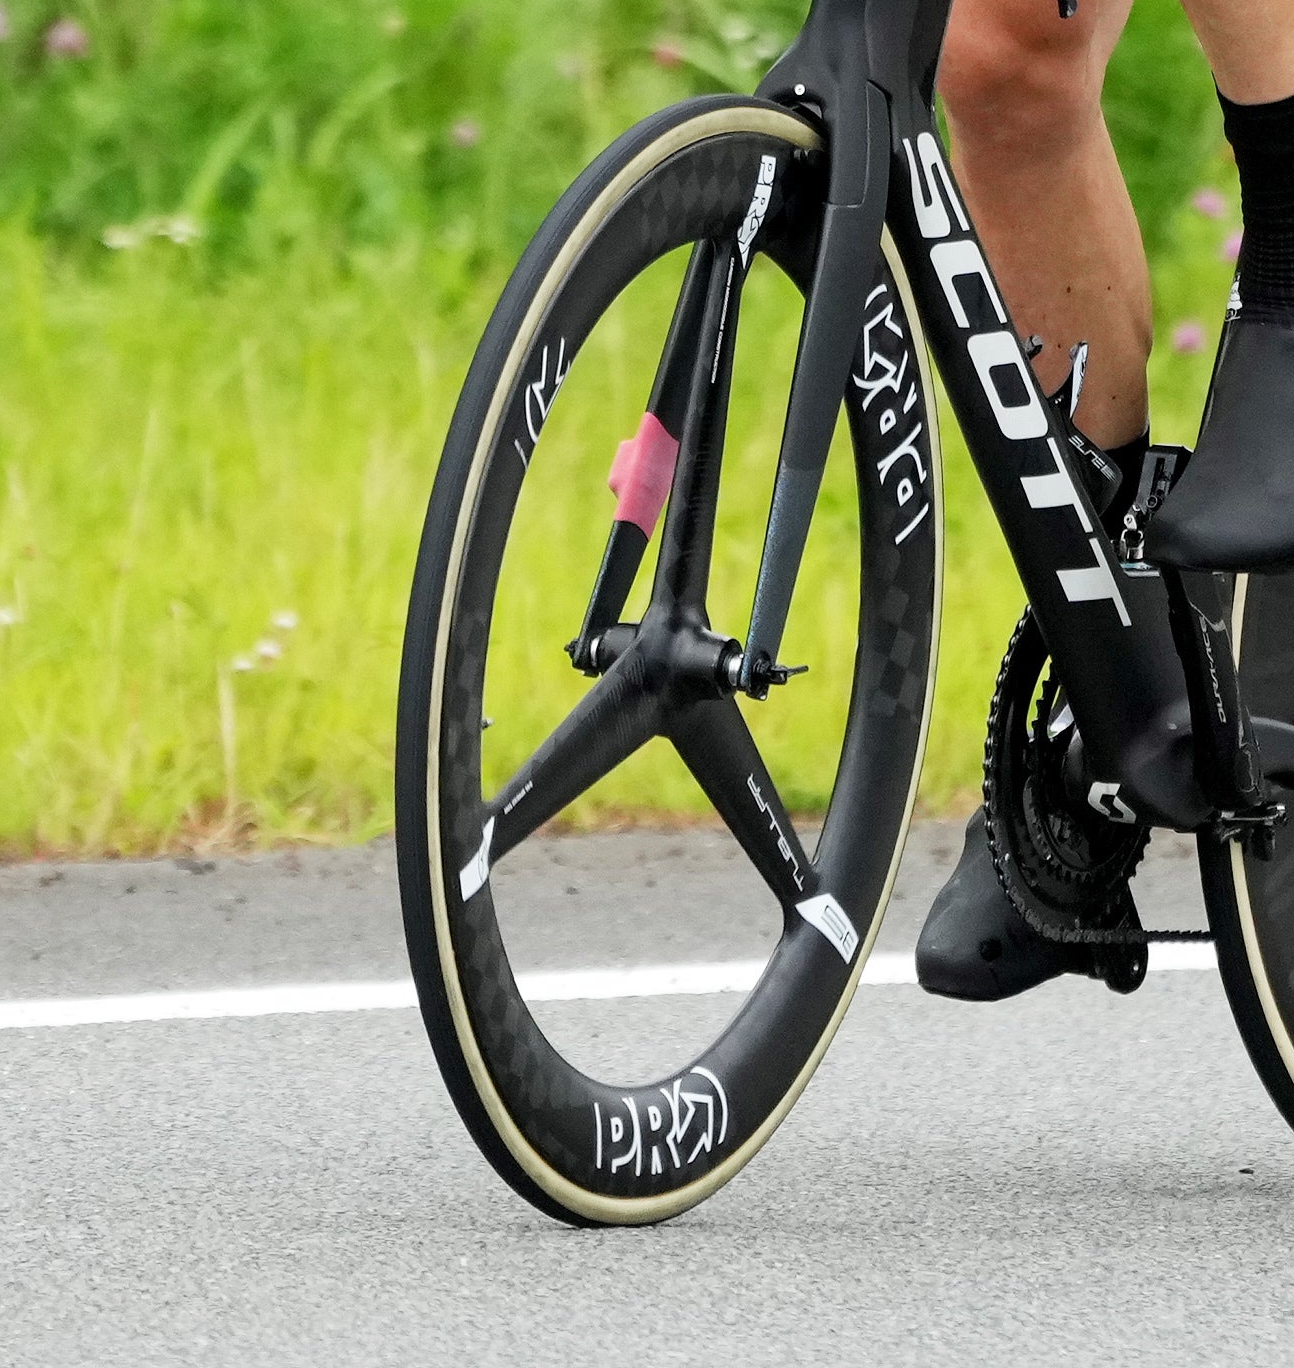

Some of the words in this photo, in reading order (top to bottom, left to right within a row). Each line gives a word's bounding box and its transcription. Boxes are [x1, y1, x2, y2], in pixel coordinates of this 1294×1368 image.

[903, 132, 1132, 628] SCOTT
[1199, 616, 1226, 723] DURA-ACE
[594, 1065, 729, 1177] PRO
